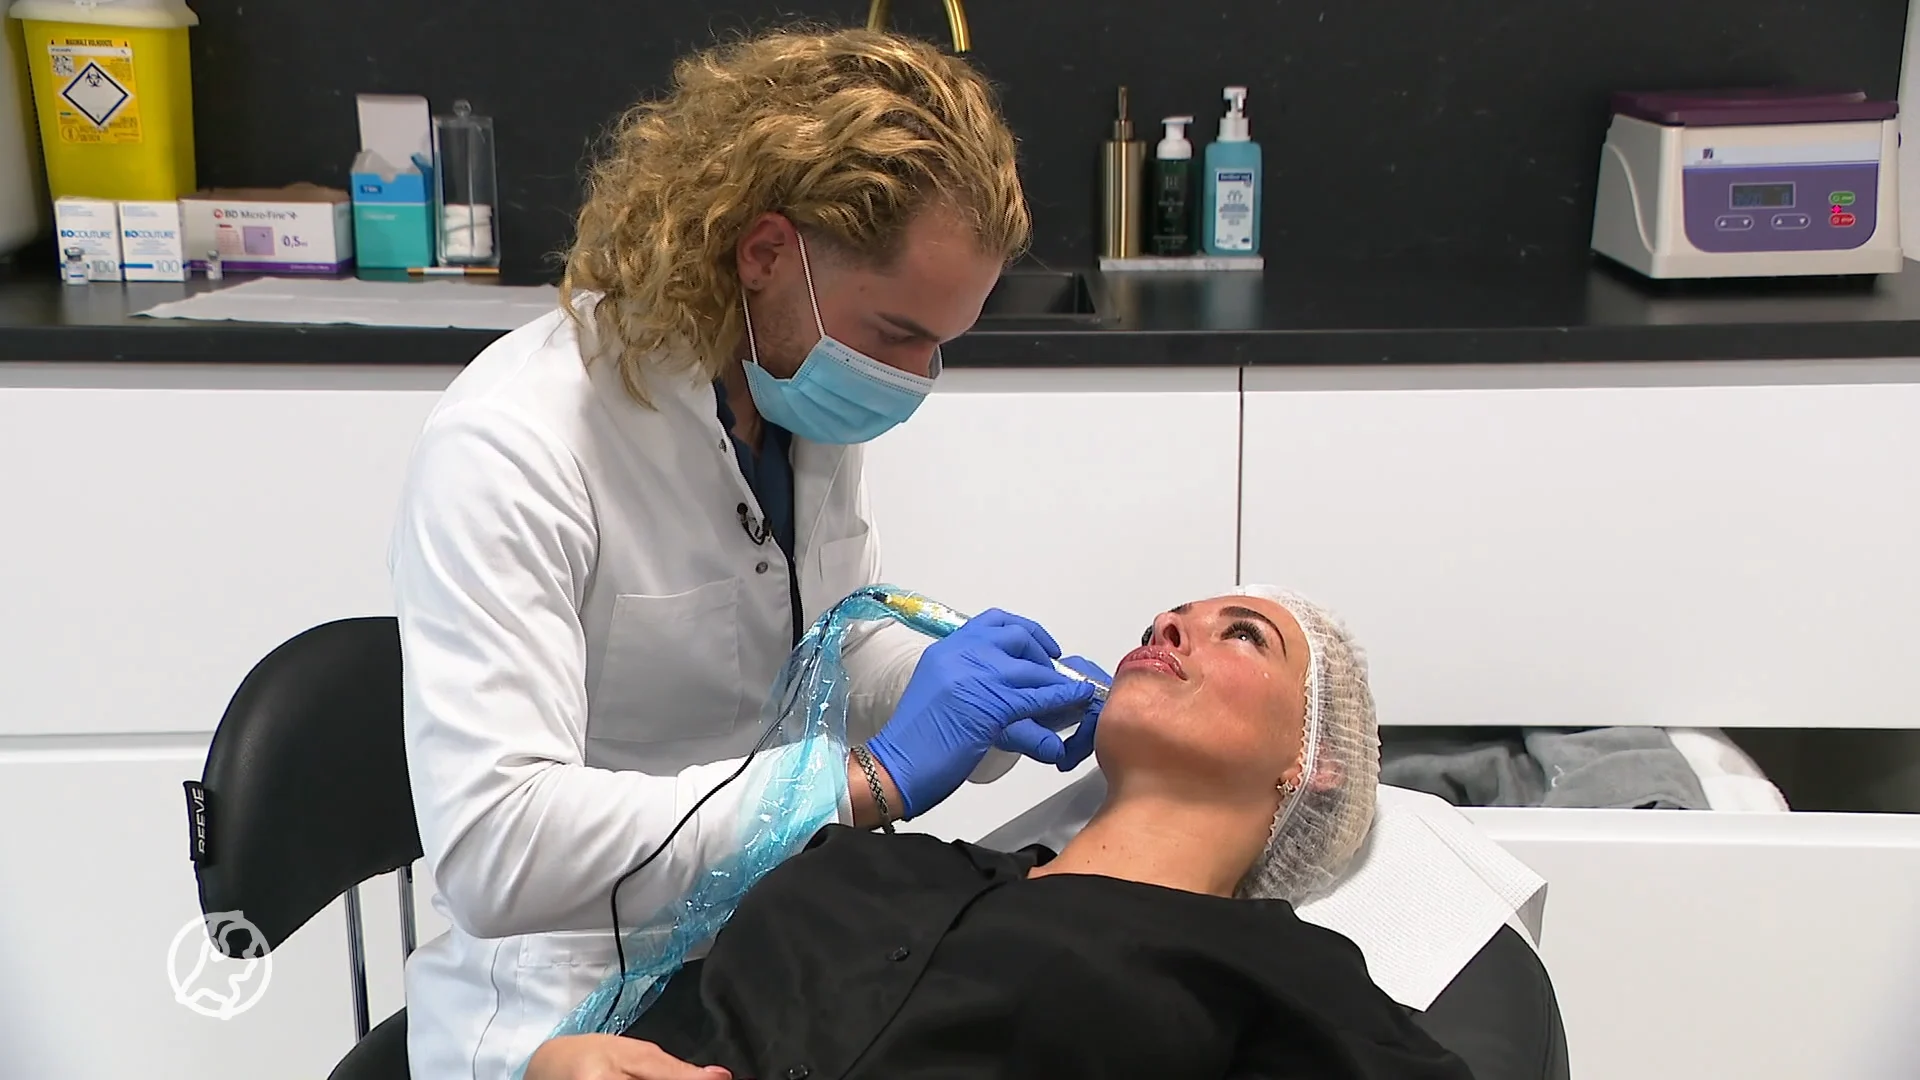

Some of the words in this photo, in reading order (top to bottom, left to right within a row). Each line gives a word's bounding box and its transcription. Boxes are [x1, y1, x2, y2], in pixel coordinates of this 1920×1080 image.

[225, 209, 239, 219] BD
[92, 260, 117, 273] 100
[155, 260, 180, 273] 100
